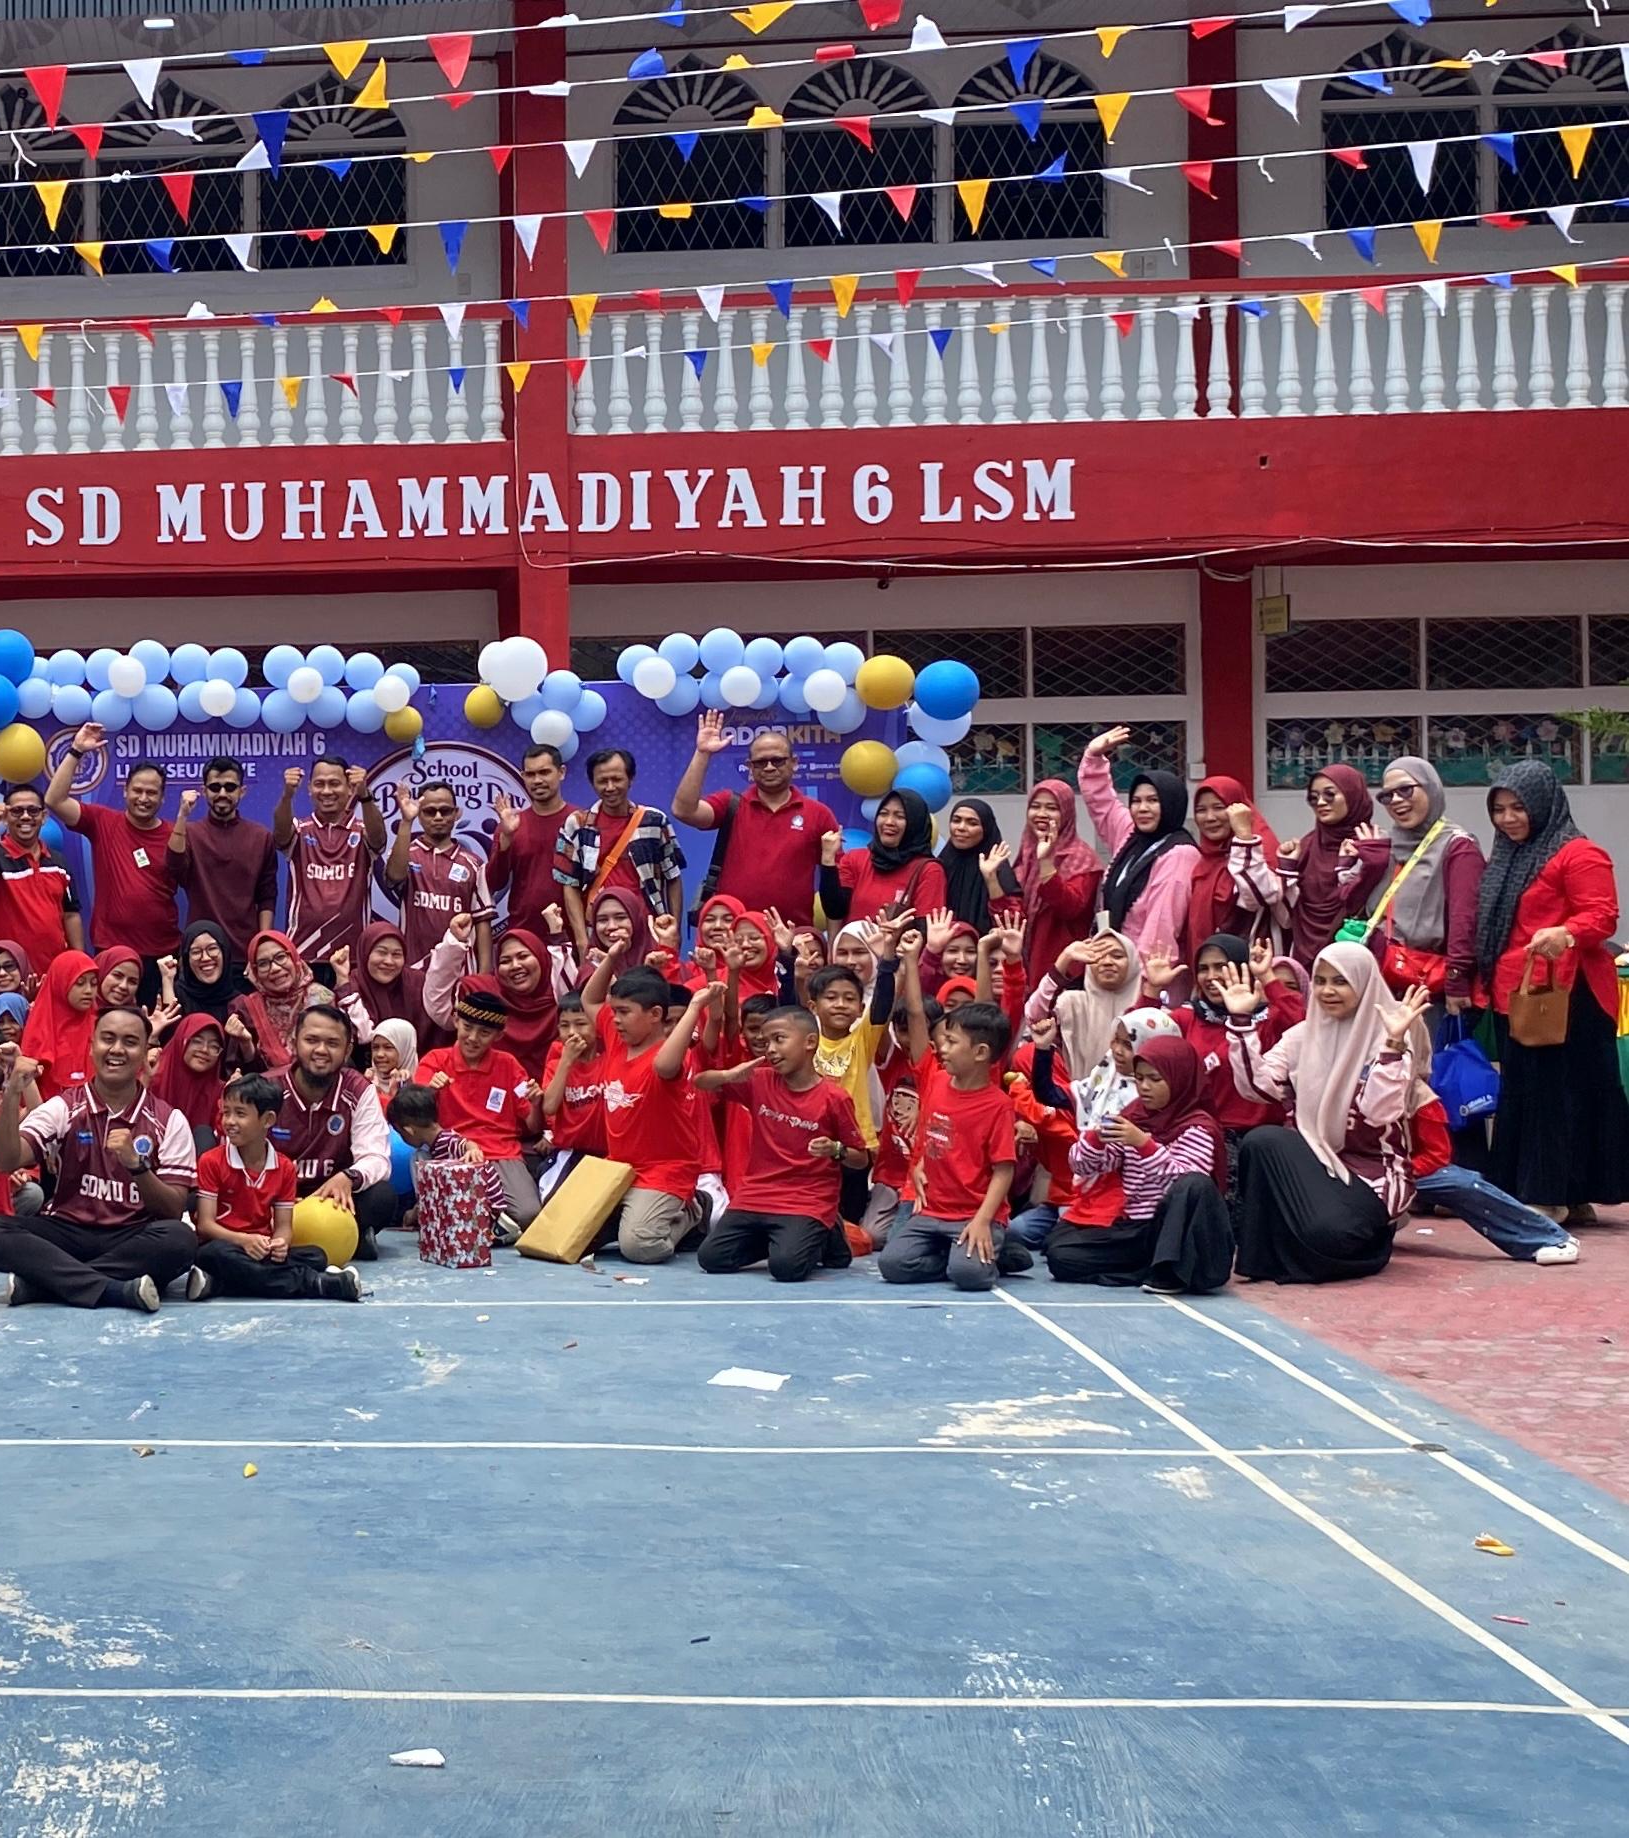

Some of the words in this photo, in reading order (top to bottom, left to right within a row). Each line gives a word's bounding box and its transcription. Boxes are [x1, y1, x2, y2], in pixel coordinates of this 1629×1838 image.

[26, 486, 121, 546] SD
[156, 466, 826, 544] MUHAMMADIYAH
[852, 463, 894, 525] 6
[920, 458, 1076, 523] LSM
[115, 735, 140, 759] SD
[146, 732, 308, 758] MUHAMMADIYAH
[313, 732, 326, 755] 6
[404, 759, 479, 785] School
[306, 863, 345, 881] SDMU
[413, 890, 450, 911] SDMU
[453, 897, 462, 912] 6
[323, 1158, 335, 1177] 6
[79, 1173, 124, 1203] SDMU
[129, 1182, 140, 1203] 6
